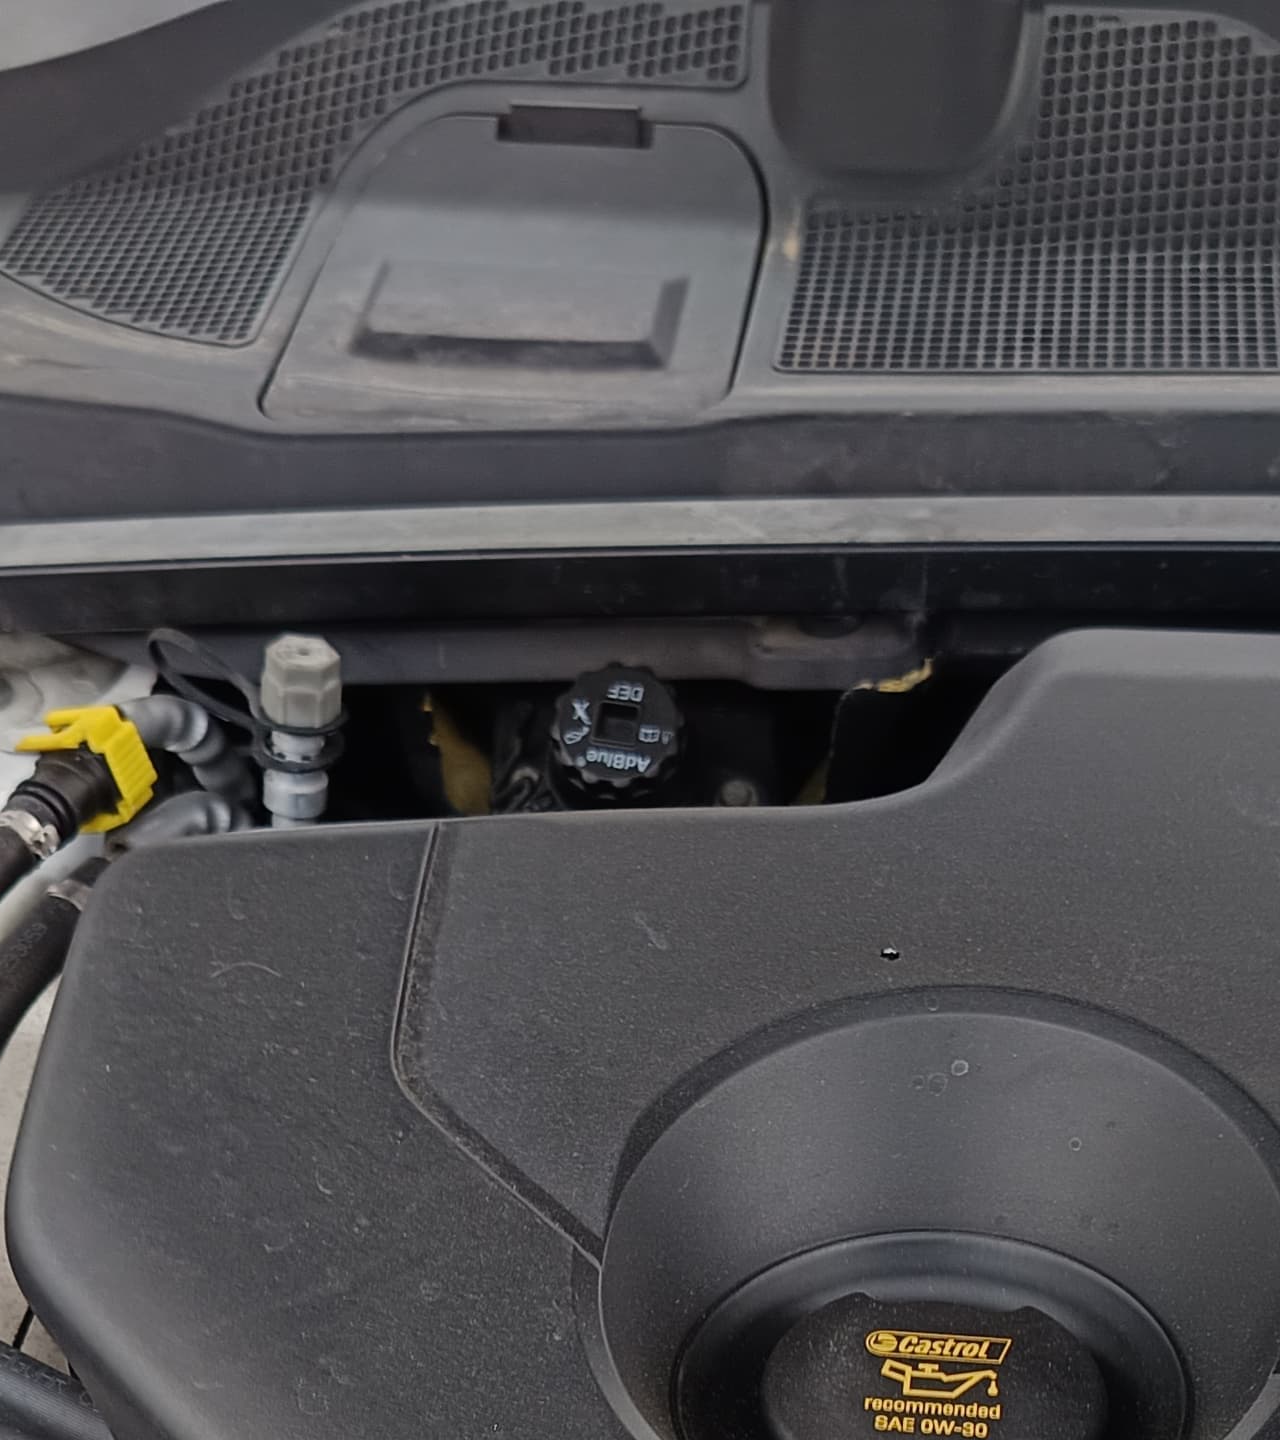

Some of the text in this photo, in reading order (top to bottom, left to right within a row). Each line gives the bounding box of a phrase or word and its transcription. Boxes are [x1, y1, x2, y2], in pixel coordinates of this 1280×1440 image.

[607, 684, 645, 702] DEF
[586, 748, 651, 773] AdBlue
[897, 1335, 992, 1359] Castrol
[864, 1396, 1001, 1420] recommended
[874, 1415, 915, 1434] SAE
